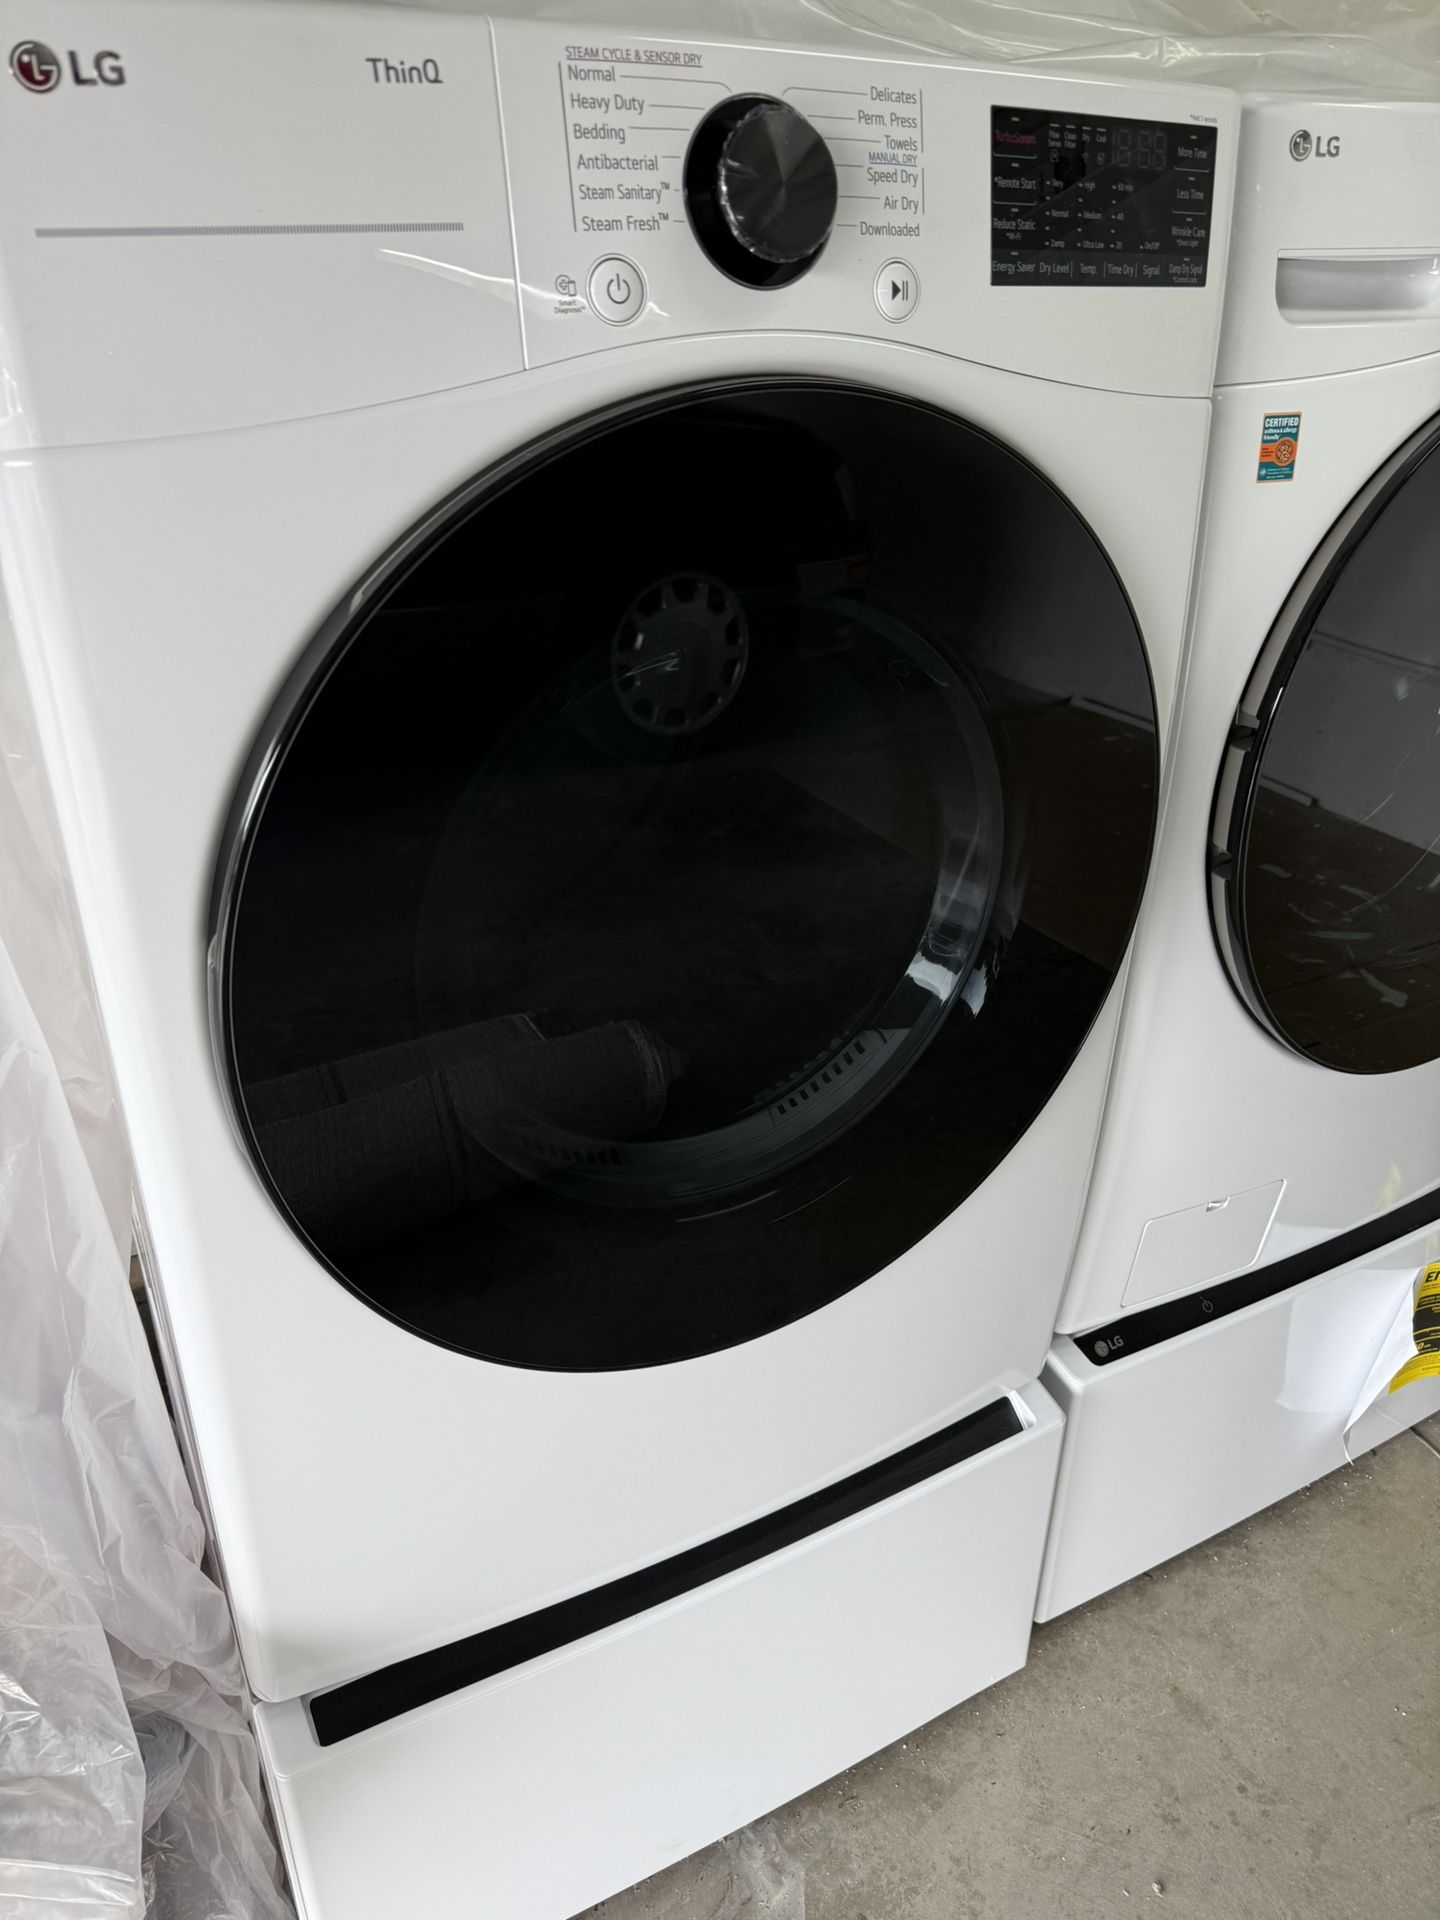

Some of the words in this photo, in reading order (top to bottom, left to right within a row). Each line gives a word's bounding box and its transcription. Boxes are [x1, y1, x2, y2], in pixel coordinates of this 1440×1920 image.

[565, 46, 599, 59] STEAM
[602, 47, 631, 60] CYCLE
[634, 49, 641, 61] &
[643, 50, 680, 64] SENSOR
[683, 53, 702, 65] DRY
[68, 50, 126, 86] LG
[365, 57, 443, 84] ThinQ
[568, 64, 616, 82] Normal
[870, 86, 917, 104] Delicates
[570, 93, 610, 114] Heavy
[614, 94, 644, 115] Duty
[858, 109, 887, 126] Perm.
[890, 112, 918, 129] Press
[573, 123, 625, 144] Bedding
[884, 134, 918, 151] Towels
[1315, 136, 1341, 158] LG
[868, 152, 900, 163] MANUAL
[902, 153, 918, 164] DRY
[1178, 146, 1193, 158] More
[1194, 148, 1208, 159] Time
[577, 153, 660, 171] Antibacterial
[867, 167, 897, 186] Speed
[900, 169, 918, 188] Dry
[1021, 177, 1036, 190] Start
[579, 184, 614, 200] Steam
[1176, 188, 1189, 199] Less
[1190, 189, 1204, 200] Time
[884, 195, 899, 210] Air
[901, 196, 919, 215] Dry
[582, 215, 623, 232] Steam
[860, 221, 920, 237] Downloaded
[993, 218, 1016, 230] Reduce
[1017, 219, 1036, 230] Static
[1171, 226, 1192, 238] Wrinkle
[1193, 227, 1206, 238] Care
[992, 261, 1016, 275] Energy
[1017, 261, 1036, 272] Saver
[1040, 262, 1051, 276] Dry
[1053, 263, 1069, 273] Level
[1108, 263, 1122, 275] Time
[1123, 264, 1134, 278] Dry
[1143, 264, 1160, 278] Signal
[1169, 264, 1181, 276] Damp
[1190, 264, 1202, 277] Signal
[1265, 417, 1299, 427] CERTIFIED
[1107, 1335, 1124, 1350] LG
